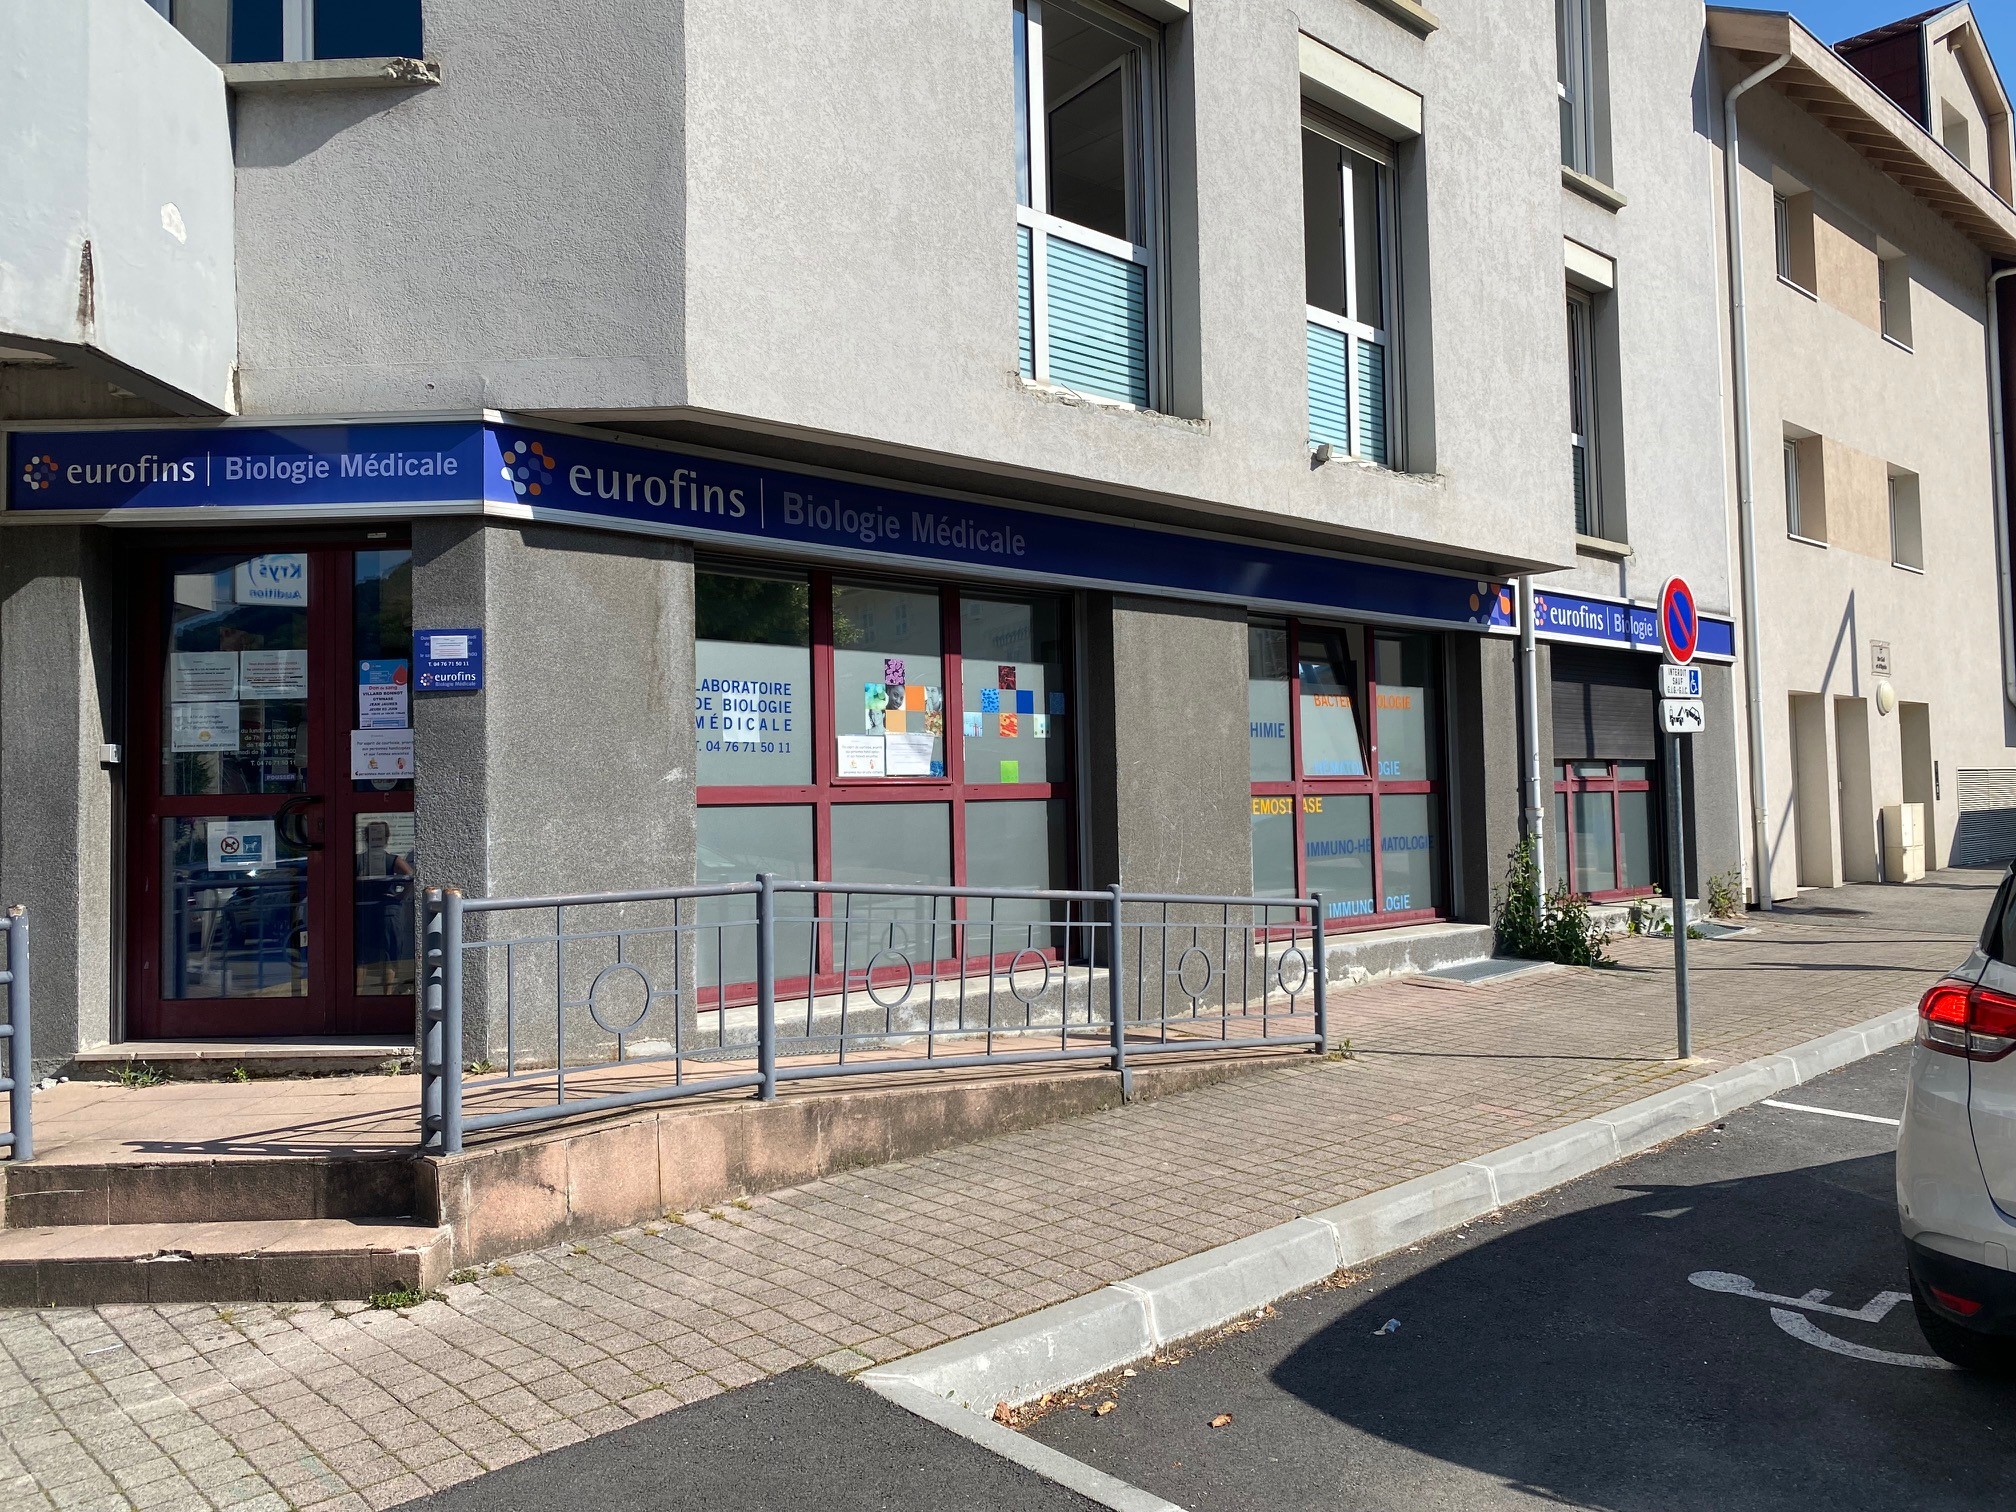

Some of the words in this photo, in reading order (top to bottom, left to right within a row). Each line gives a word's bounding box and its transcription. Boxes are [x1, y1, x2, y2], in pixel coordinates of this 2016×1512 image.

[67, 455, 195, 483] eurofins
[226, 455, 330, 484] Biologie
[340, 453, 458, 478] Médicale
[568, 463, 746, 518] eurofins
[783, 492, 900, 543] Biologie
[912, 511, 1025, 556] Médicale
[1550, 605, 1604, 631] eurofins
[1613, 613, 1653, 640] Biologie
[435, 671, 476, 682] eurofins
[696, 679, 792, 696] ABORATOIRE
[696, 697, 712, 711] DE
[723, 699, 792, 714] BIOLOGIE
[696, 713, 792, 732] MÉDICALE
[1250, 722, 1286, 739] HIMIE
[706, 740, 720, 751] 04
[725, 741, 740, 752] 76
[743, 742, 756, 752] 71
[761, 742, 774, 752] 50
[779, 743, 791, 753] 11
[1252, 797, 1323, 816] ÉMOSTASE
[1328, 895, 1411, 919] IMMUNOOGIE
